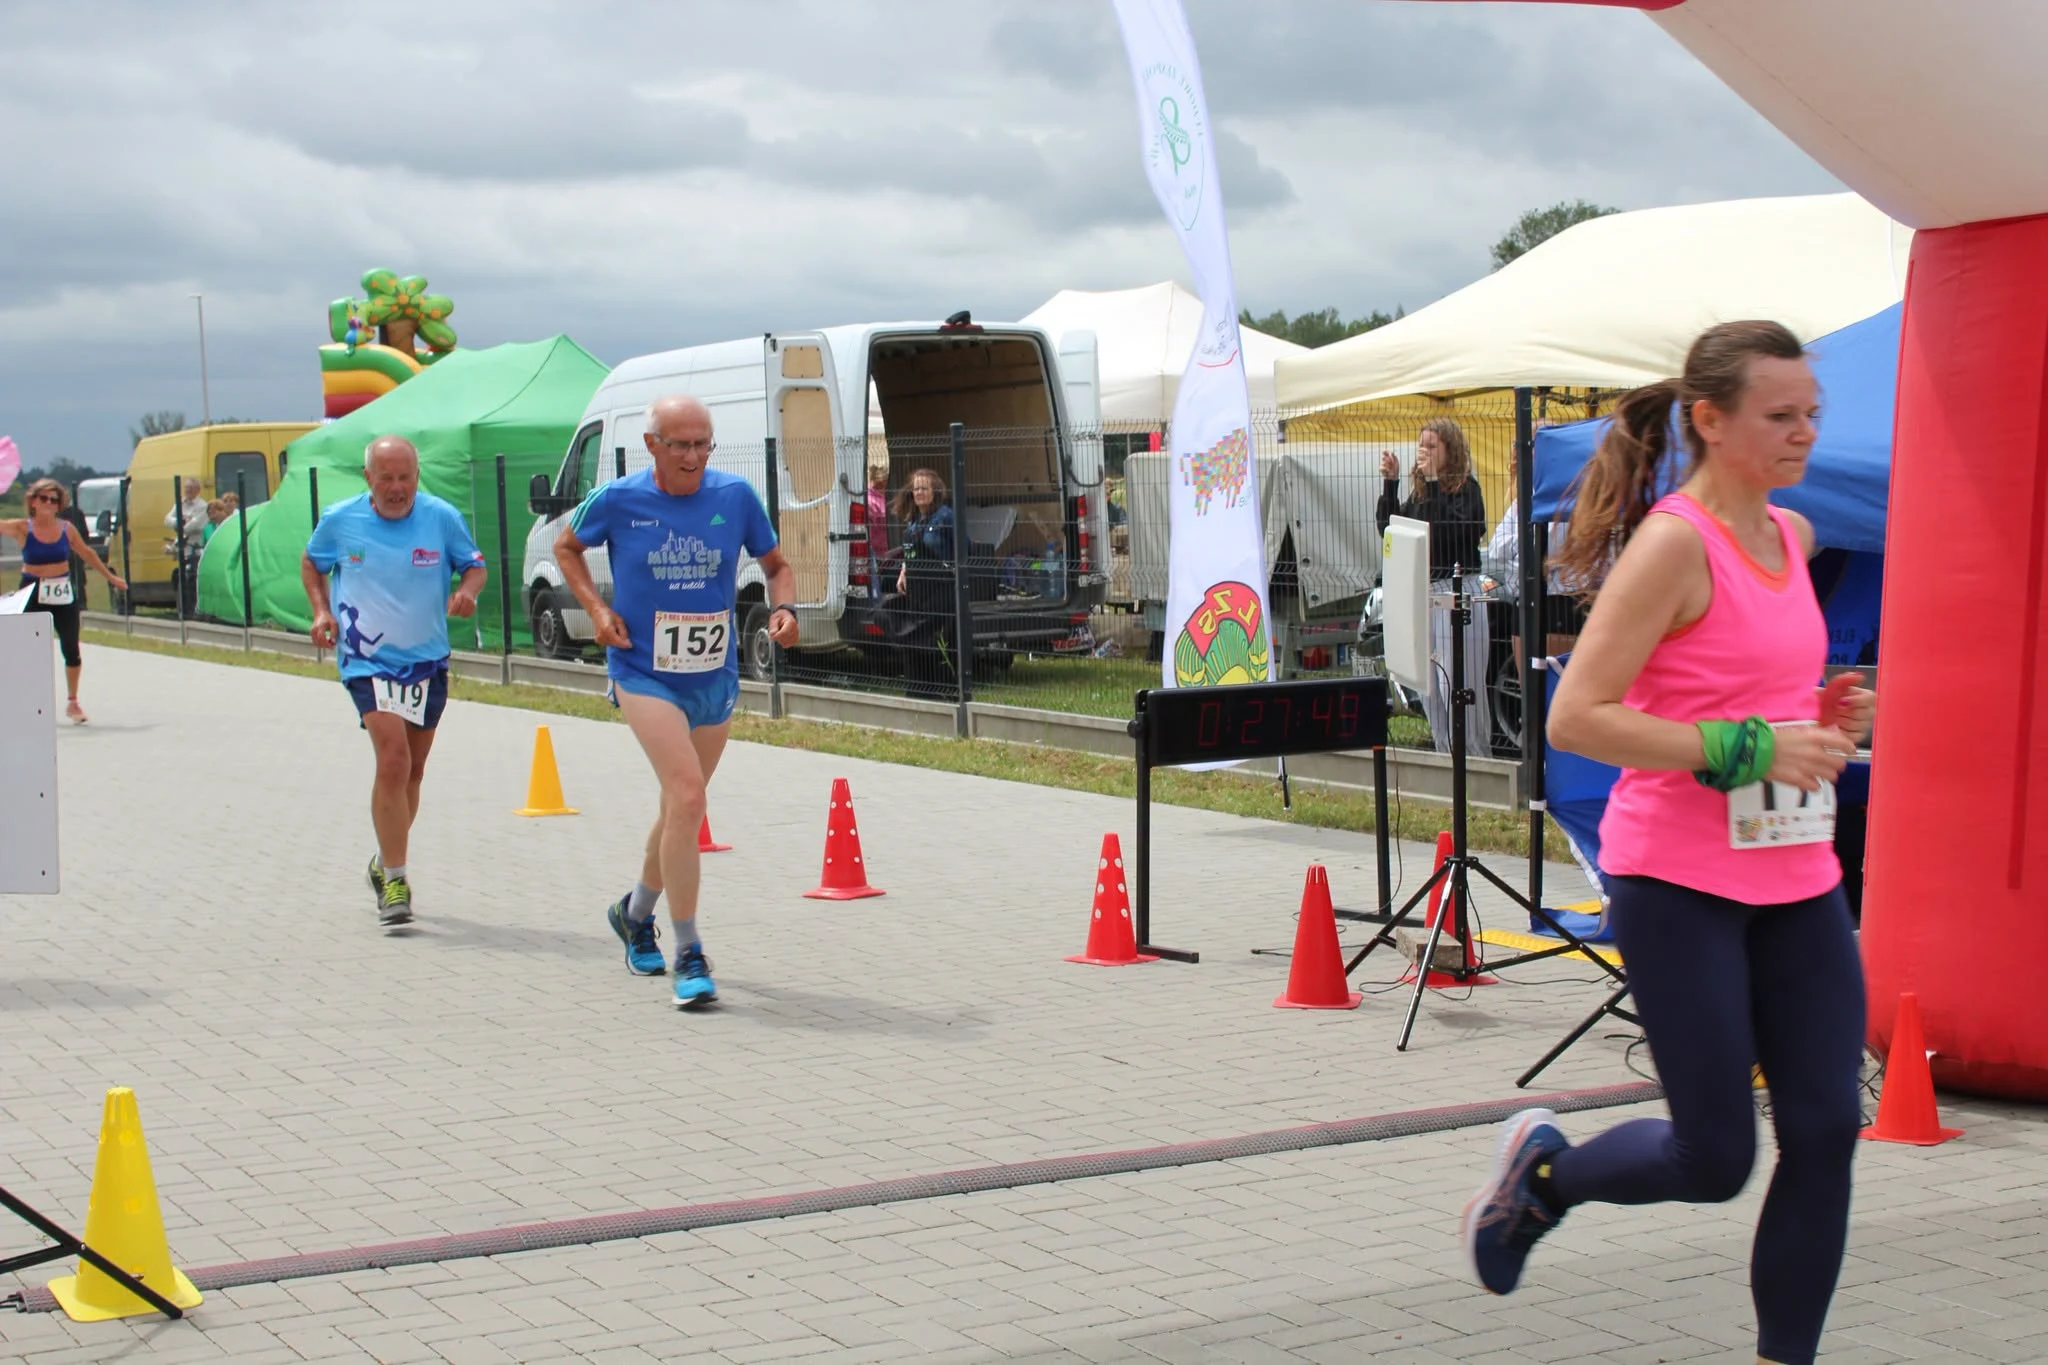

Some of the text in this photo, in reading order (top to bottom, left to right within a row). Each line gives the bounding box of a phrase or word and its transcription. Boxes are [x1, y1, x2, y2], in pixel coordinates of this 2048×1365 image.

[648, 550, 691, 565] MIŁO
[652, 564, 720, 580] WIDZIEĆ
[44, 584, 70, 597] 164
[665, 624, 725, 656] 152
[381, 679, 423, 708] 119
[1198, 694, 1359, 746] 0:27:49
